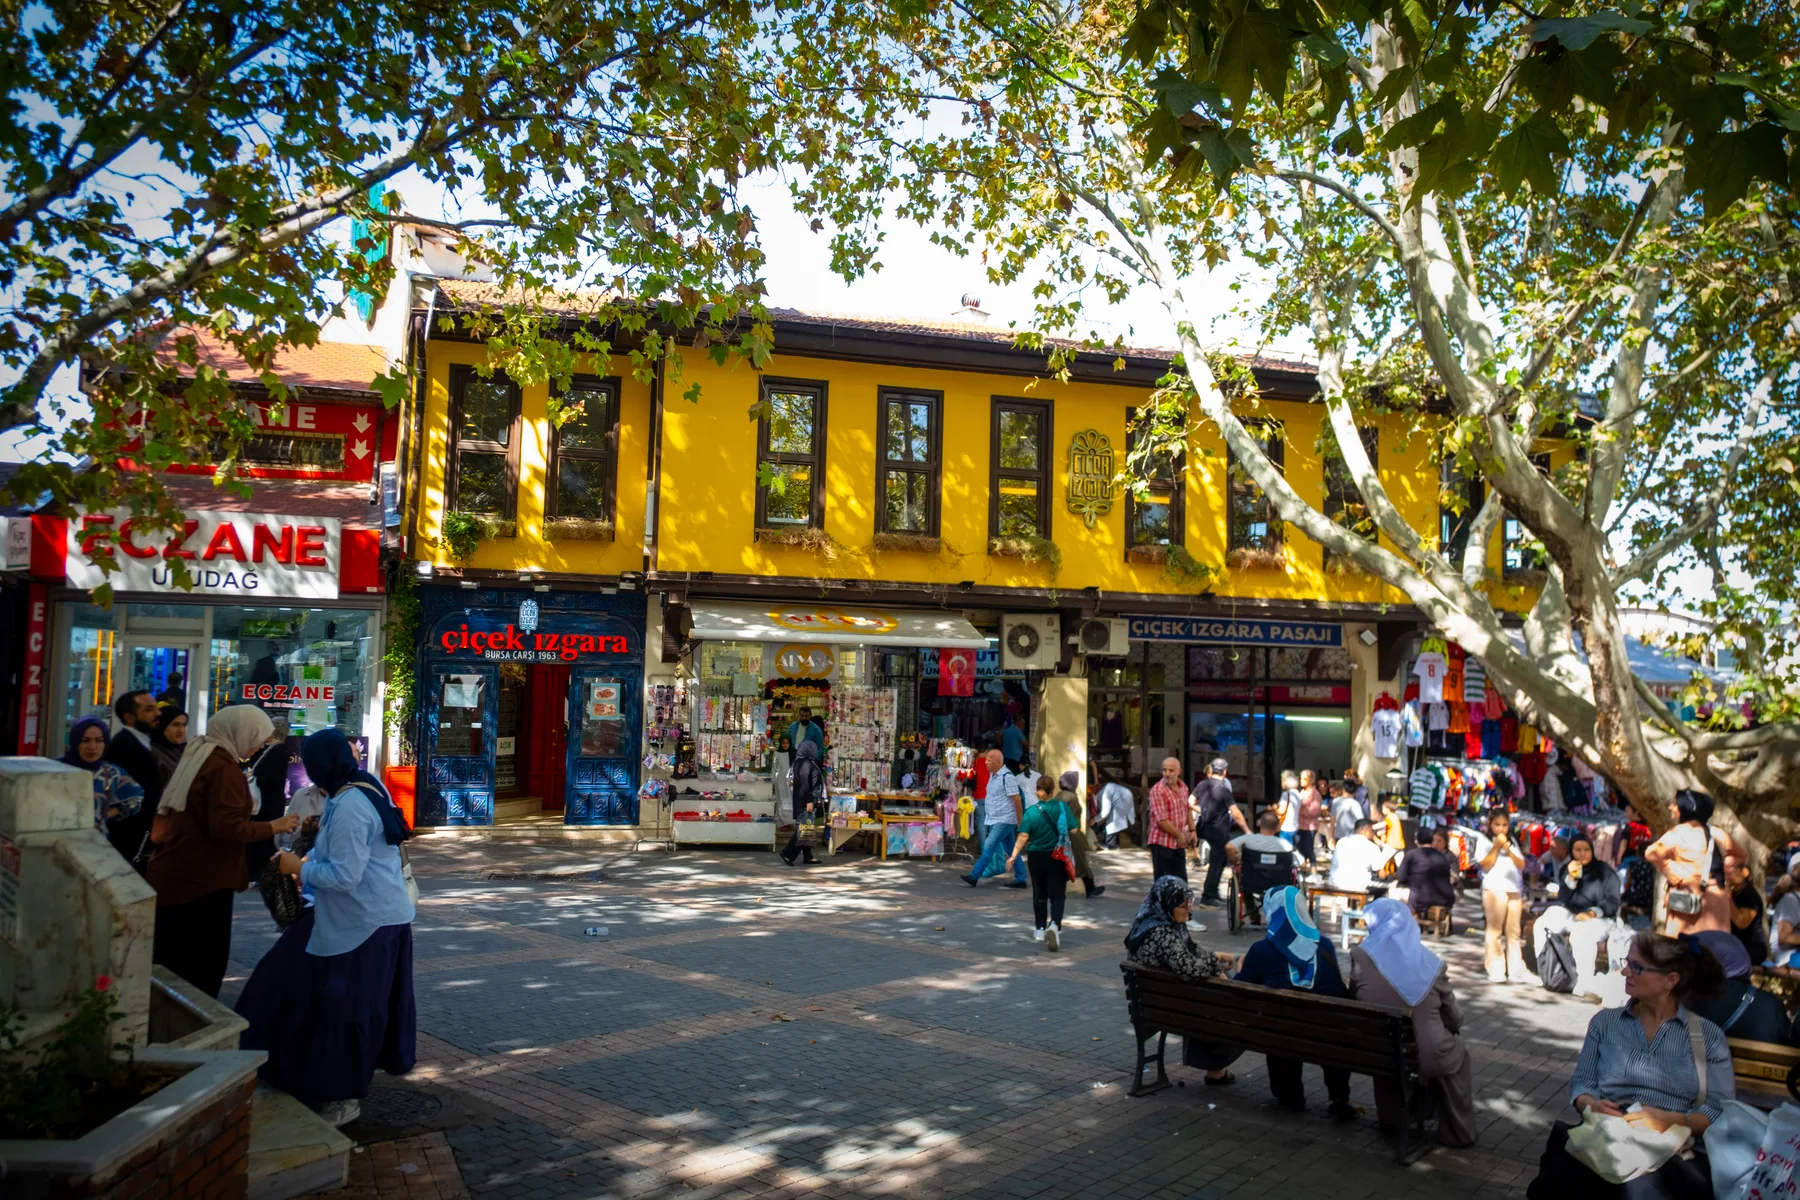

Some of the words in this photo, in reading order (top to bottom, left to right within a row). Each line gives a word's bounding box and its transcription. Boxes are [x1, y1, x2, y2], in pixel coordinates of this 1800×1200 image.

[82, 515, 326, 566] ECZANE
[151, 568, 257, 589] UUDAĞ
[441, 624, 524, 655] çiçek
[1191, 623, 1263, 639] IZGARA
[485, 650, 510, 660] BURSA
[513, 651, 535, 661] ÇARŞI
[538, 652, 556, 661] 1963
[1427, 664, 1436, 678] 8
[242, 683, 335, 701] ECZANE
[1380, 725, 1391, 738] 15
